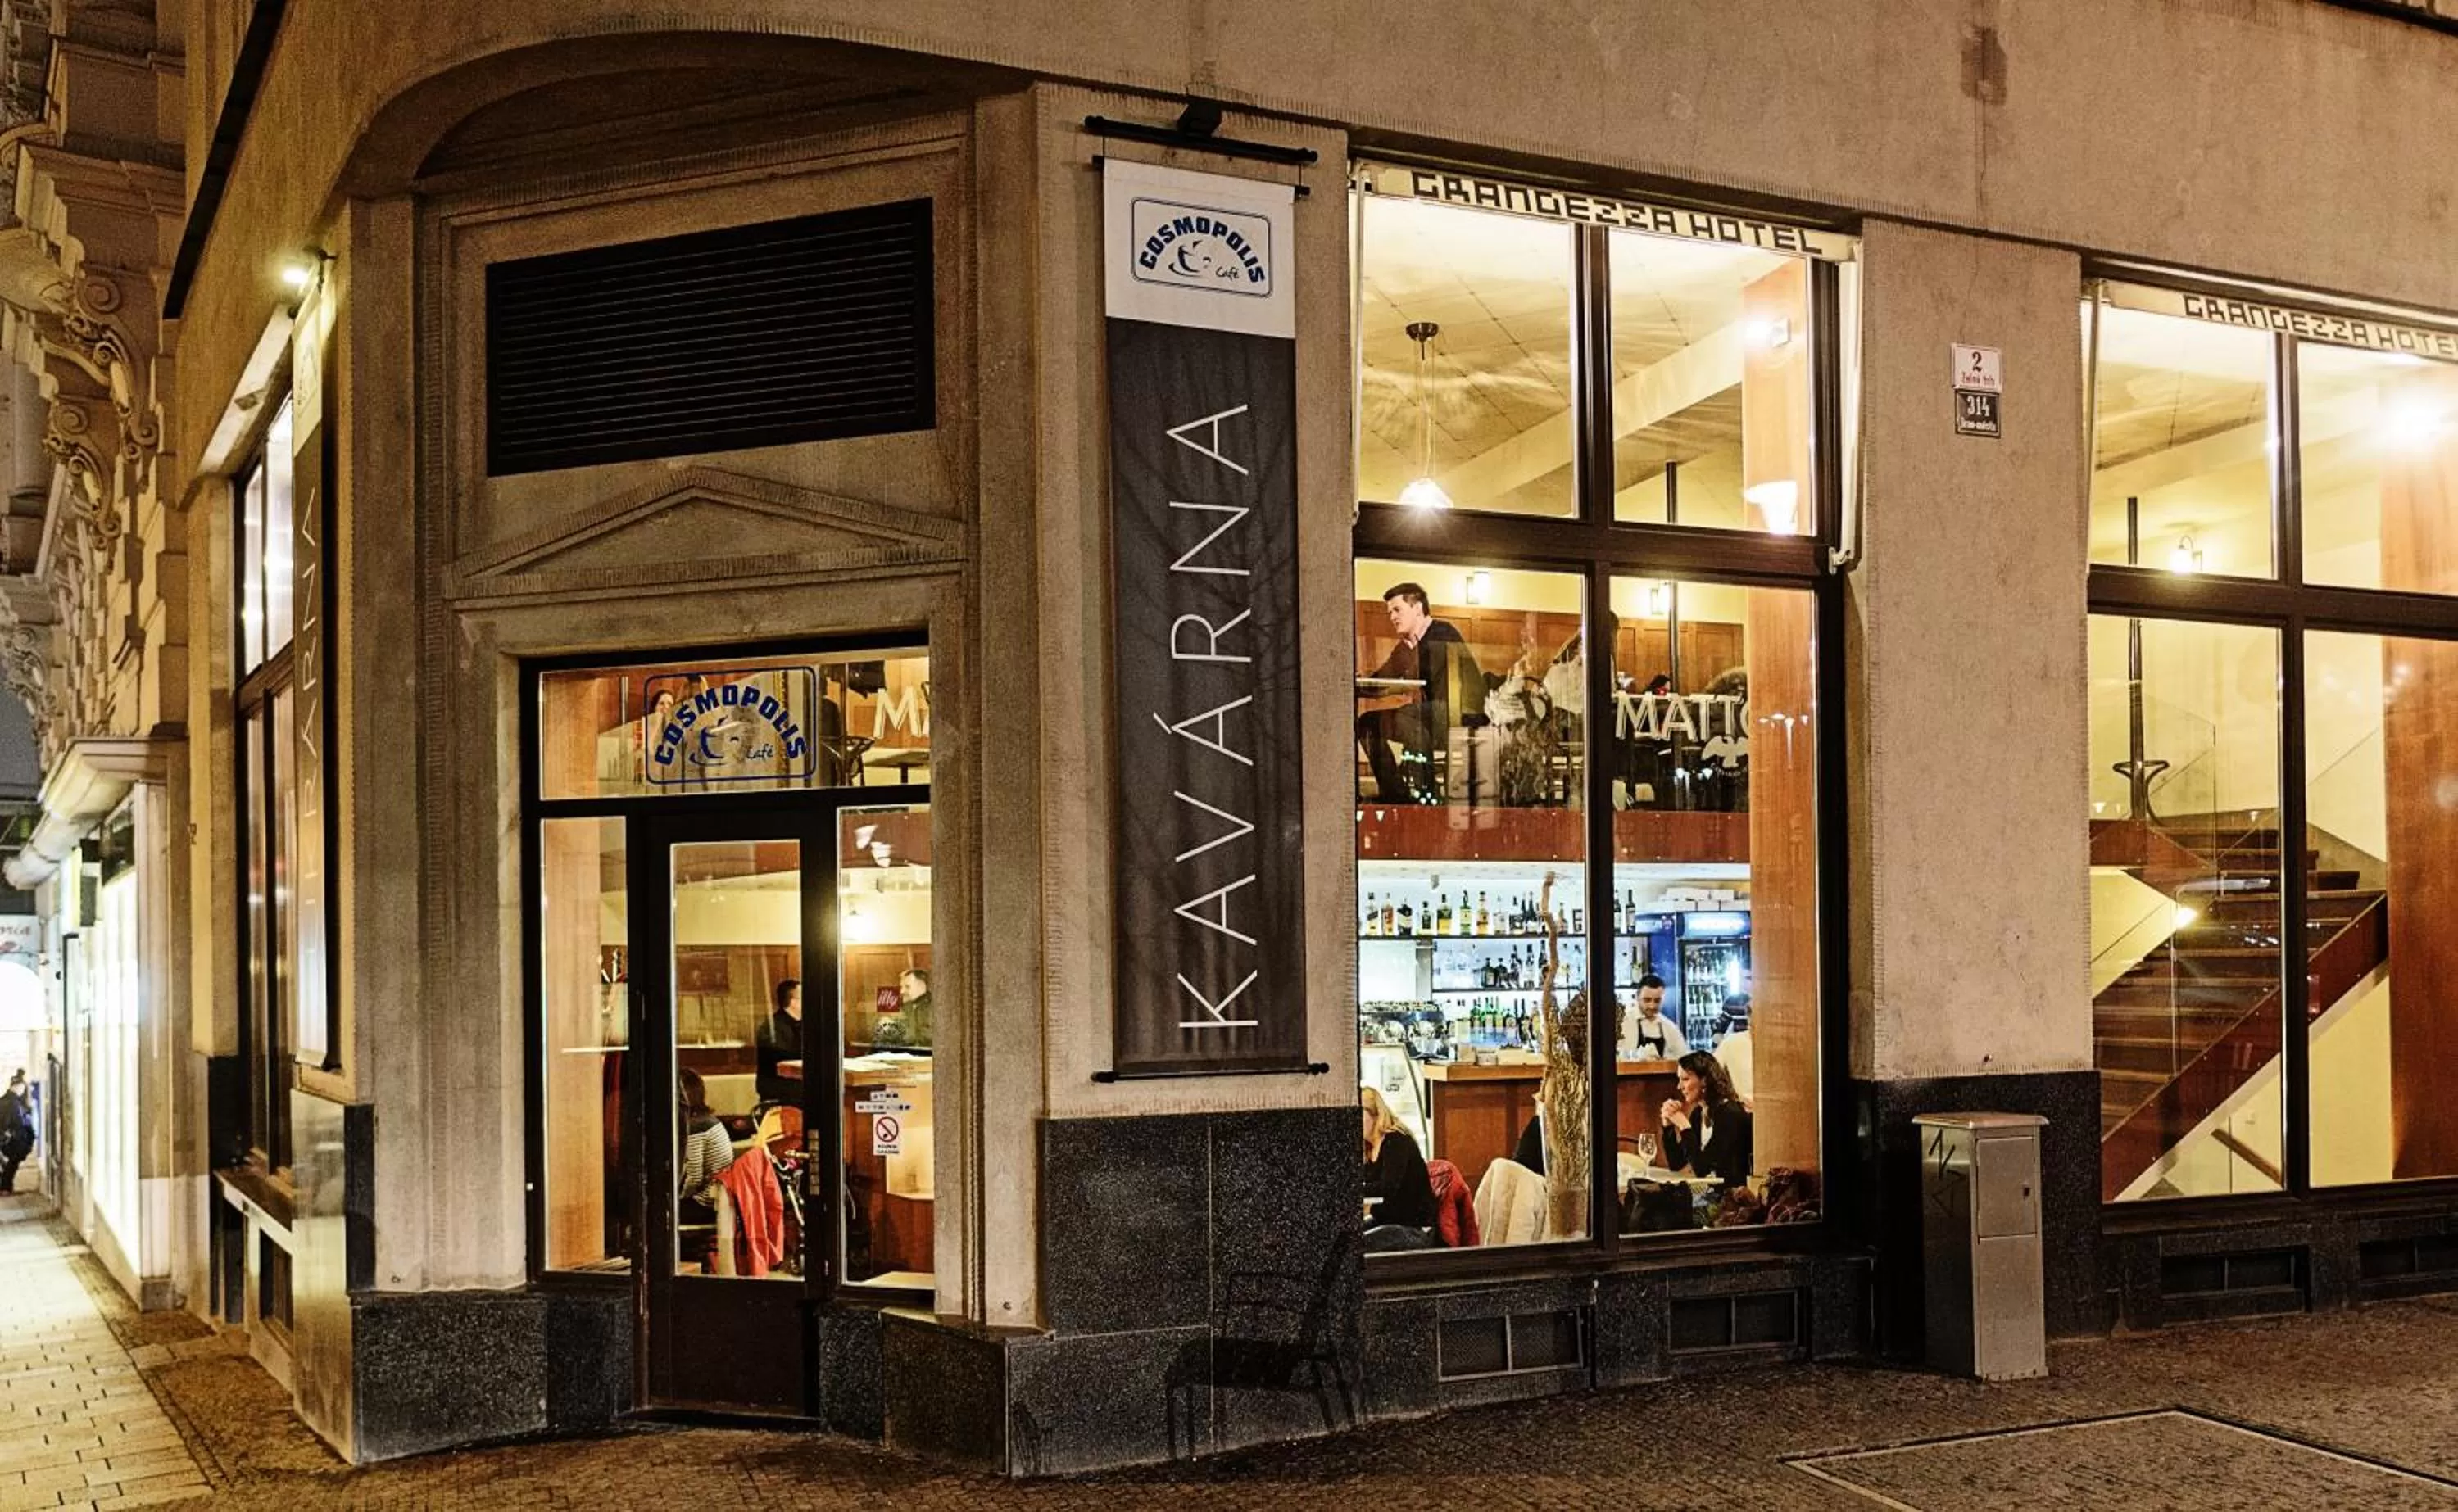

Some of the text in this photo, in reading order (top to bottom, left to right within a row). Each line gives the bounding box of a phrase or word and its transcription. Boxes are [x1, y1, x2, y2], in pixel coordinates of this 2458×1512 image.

[1412, 170, 1822, 255] GRANDEZZA HOTEL
[1139, 216, 1265, 283] COSMOPOLIS
[2184, 294, 2458, 355] GRANDEZZA HOTE
[1971, 351, 1983, 372] 2
[1967, 395, 1990, 417] 314
[655, 685, 807, 766] COSMOPOLIS
[1153, 403, 1258, 1028] KAVÁRNA
[878, 989, 898, 1009] illy
